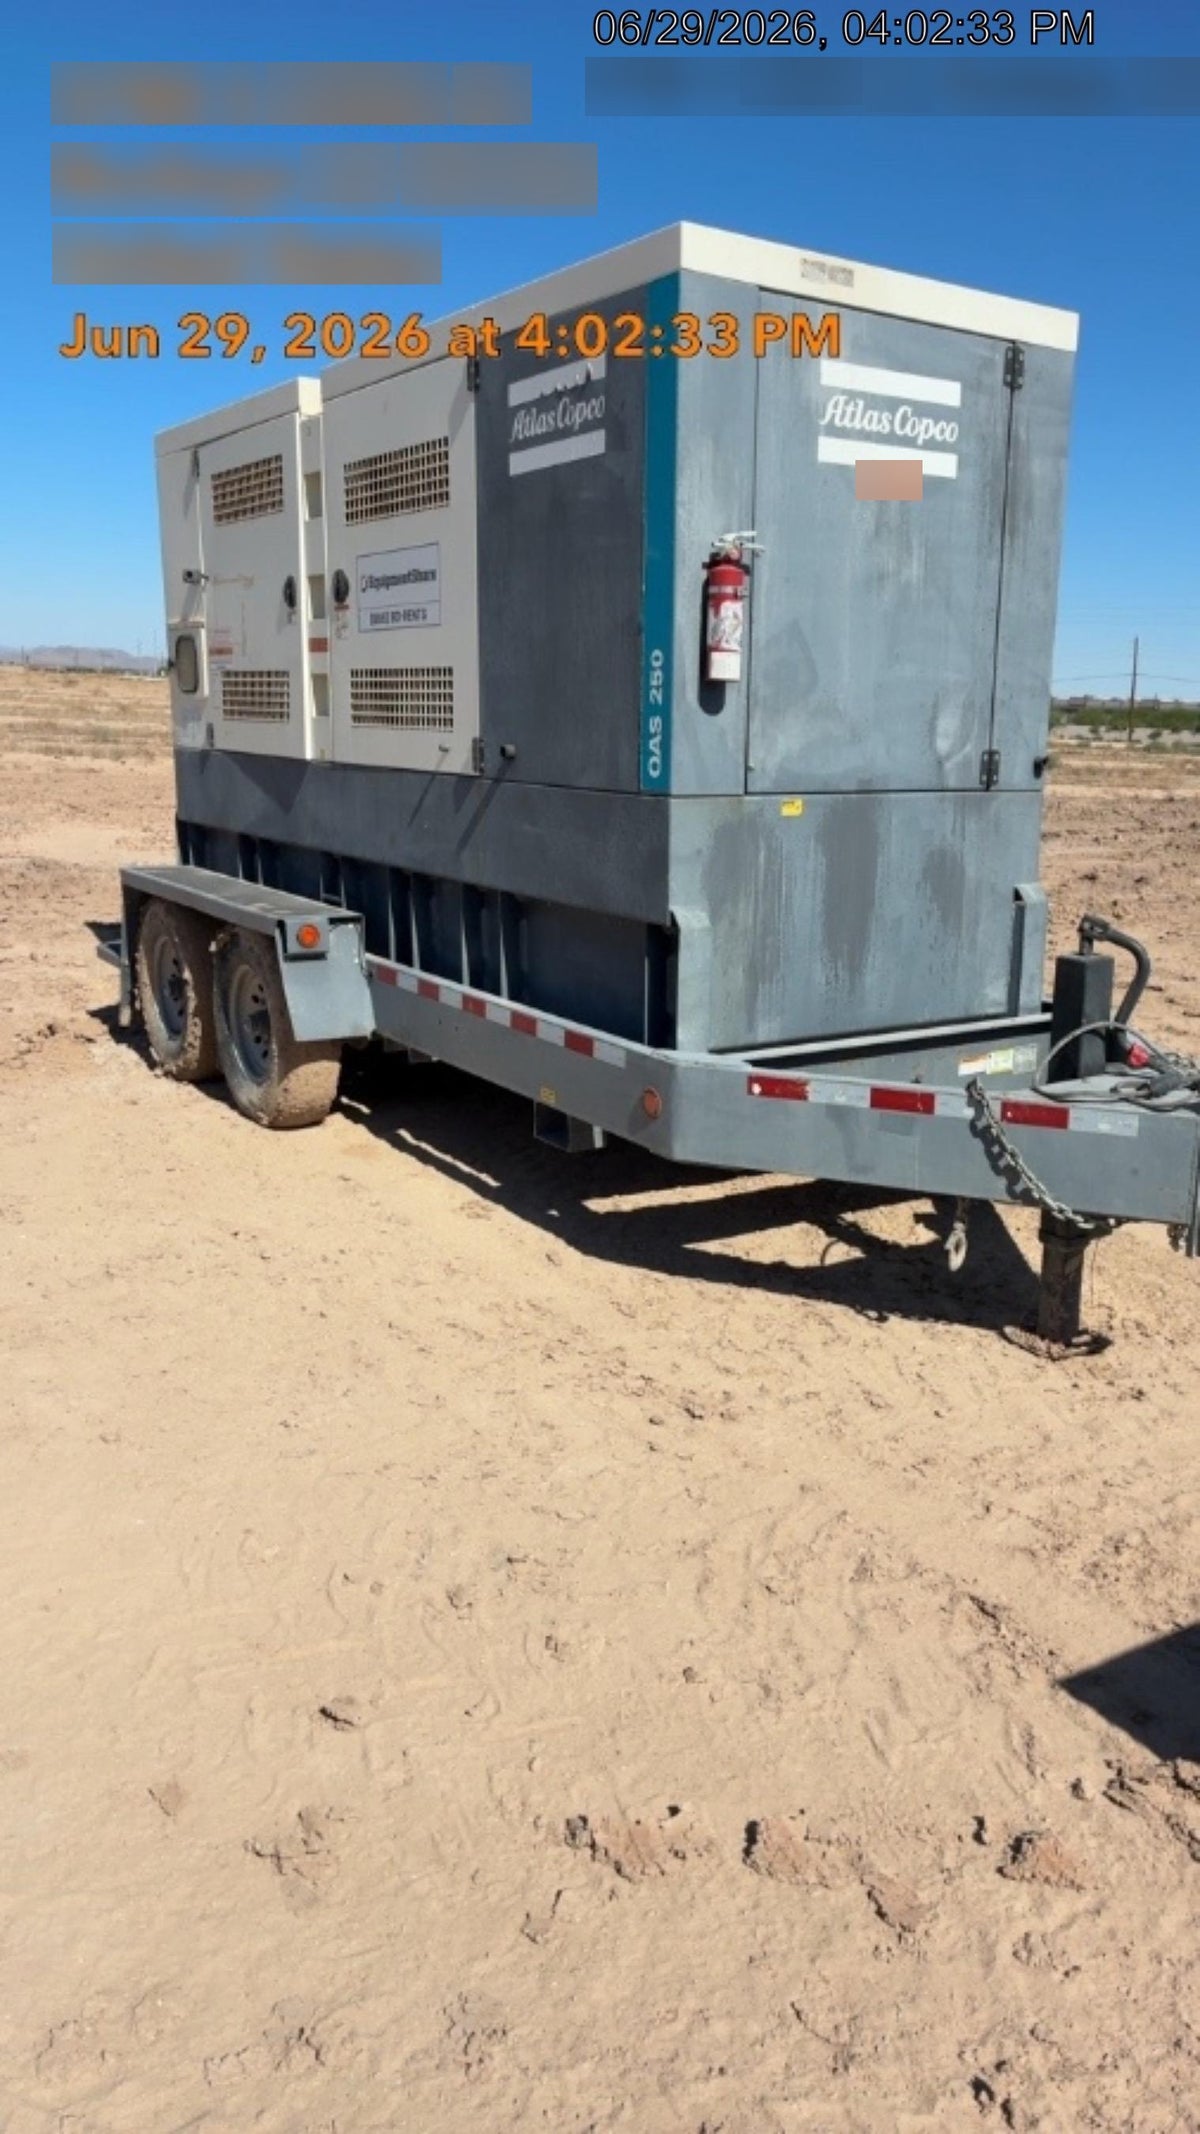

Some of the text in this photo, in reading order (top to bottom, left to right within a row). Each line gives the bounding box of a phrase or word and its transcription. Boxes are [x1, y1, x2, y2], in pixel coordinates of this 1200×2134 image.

[510, 396, 605, 442] Atlas Copco
[819, 395, 959, 446] Atlas Copco
[650, 649, 664, 705] 250
